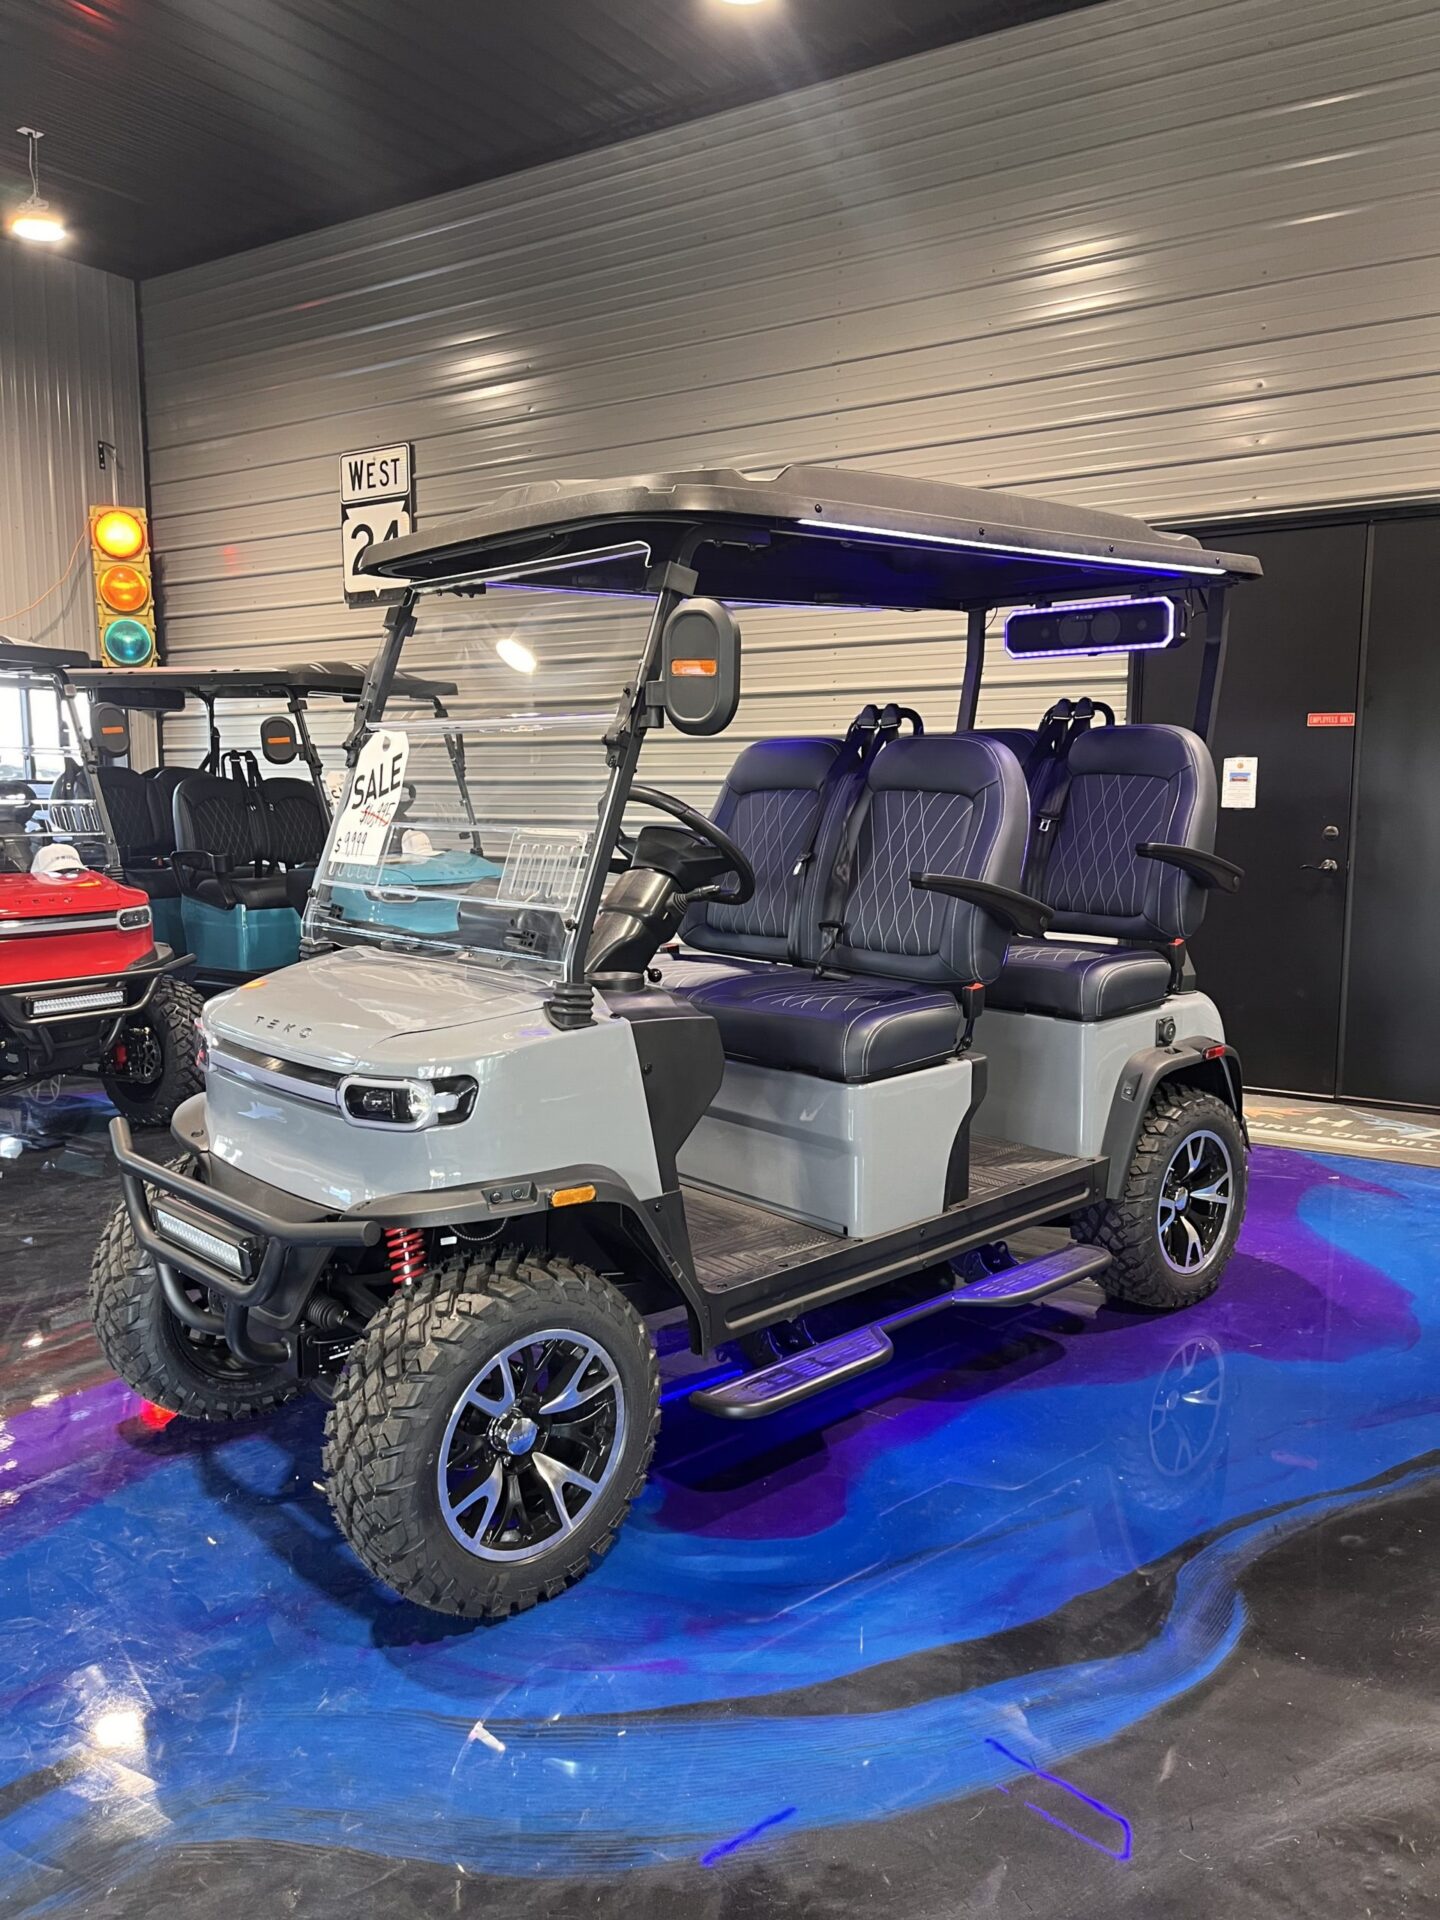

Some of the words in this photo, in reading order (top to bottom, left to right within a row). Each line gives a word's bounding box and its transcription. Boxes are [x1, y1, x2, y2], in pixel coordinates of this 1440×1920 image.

[348, 457, 400, 491] WEST
[352, 753, 403, 809] SALE
[254, 1015, 313, 1039] TEKO
[1246, 1121, 1324, 1135] ARTS
[1330, 1131, 1373, 1140] OF
